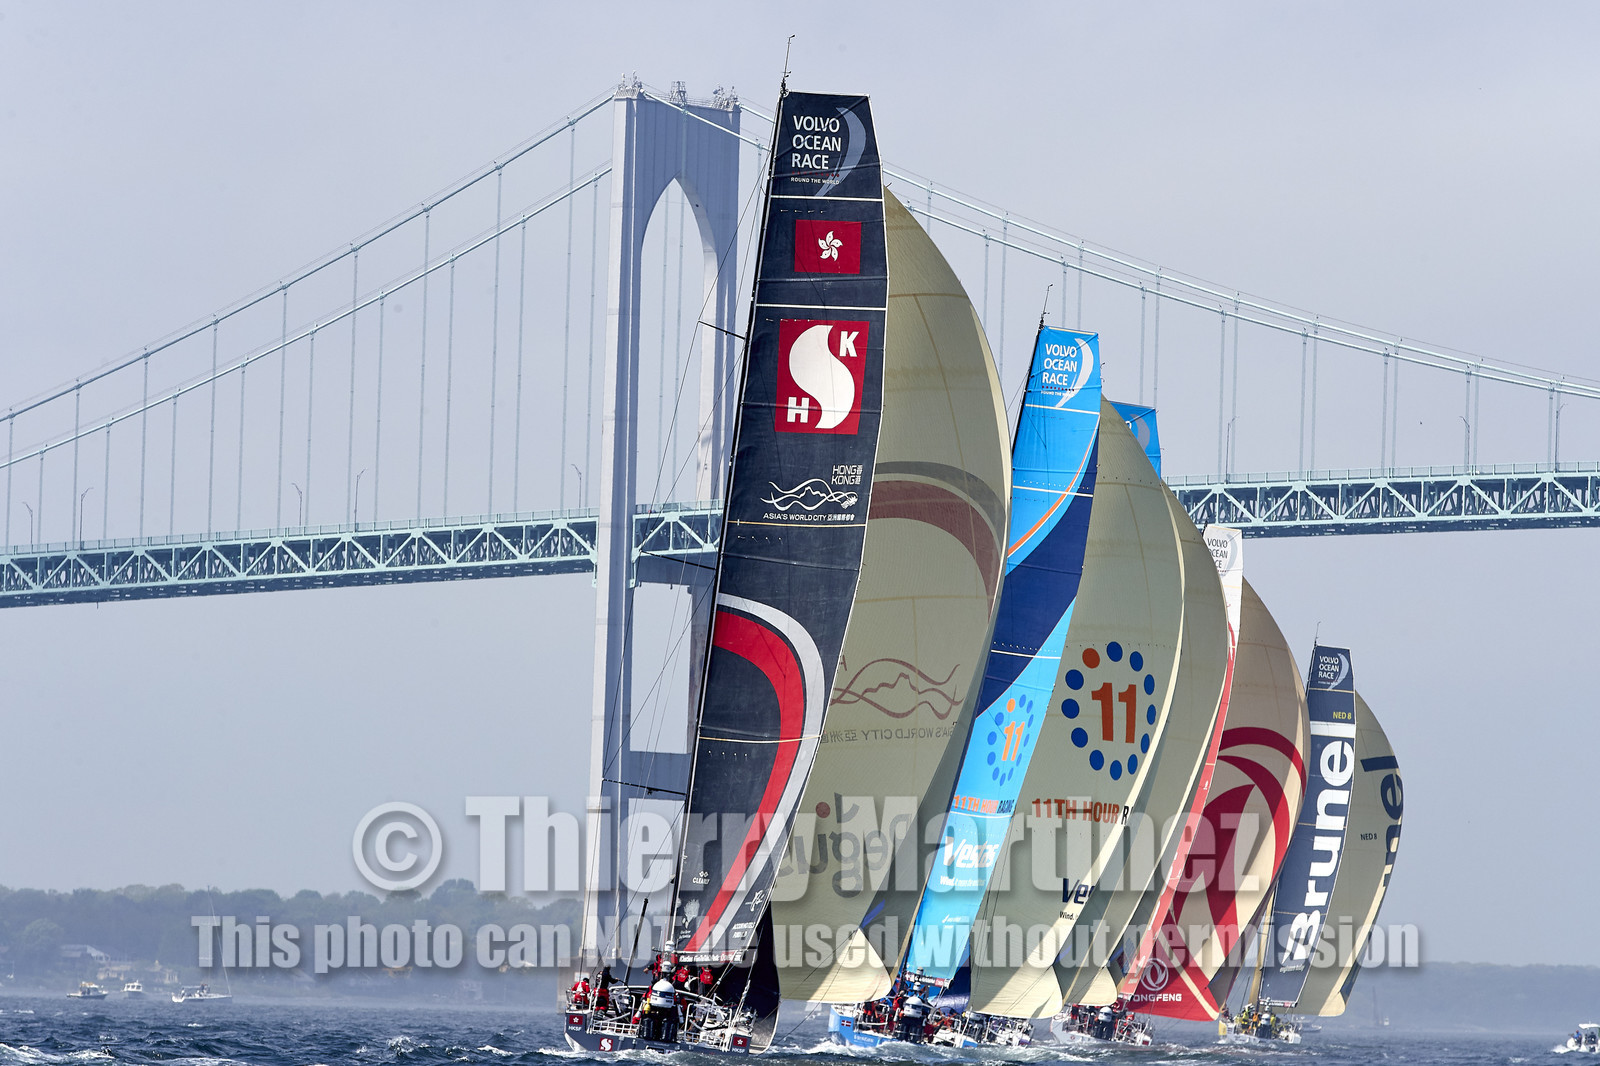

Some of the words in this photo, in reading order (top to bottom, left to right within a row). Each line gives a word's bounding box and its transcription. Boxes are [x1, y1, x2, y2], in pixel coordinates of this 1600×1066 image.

[793, 115, 840, 133] VOLVO
[792, 134, 842, 152] OCEAN
[791, 153, 829, 170] RACE
[1045, 343, 1077, 358] VOLVO
[1044, 357, 1078, 373] OCEAN
[1042, 372, 1068, 386] RACE
[832, 465, 857, 475] HONG
[831, 475, 855, 485] KONG
[1207, 537, 1228, 549] VOLVO
[1319, 655, 1339, 664] VOLVO
[1318, 663, 1340, 673] OCEAN
[1318, 671, 1334, 680] RACE
[1091, 682, 1137, 744] 11
[1332, 711, 1347, 720] NED
[1347, 712, 1352, 720] 8
[1001, 721, 1025, 762] 11
[954, 794, 980, 812] 11TH
[980, 798, 999, 814] HOUR
[1032, 798, 1077, 820] 11TH
[1082, 799, 1120, 824] HOUR
[1360, 833, 1372, 841] NED
[1373, 833, 1378, 841] 8
[943, 836, 1000, 869] Vestas
[1059, 911, 1074, 920] Wind.
[1131, 993, 1182, 1002] ONGFENG
